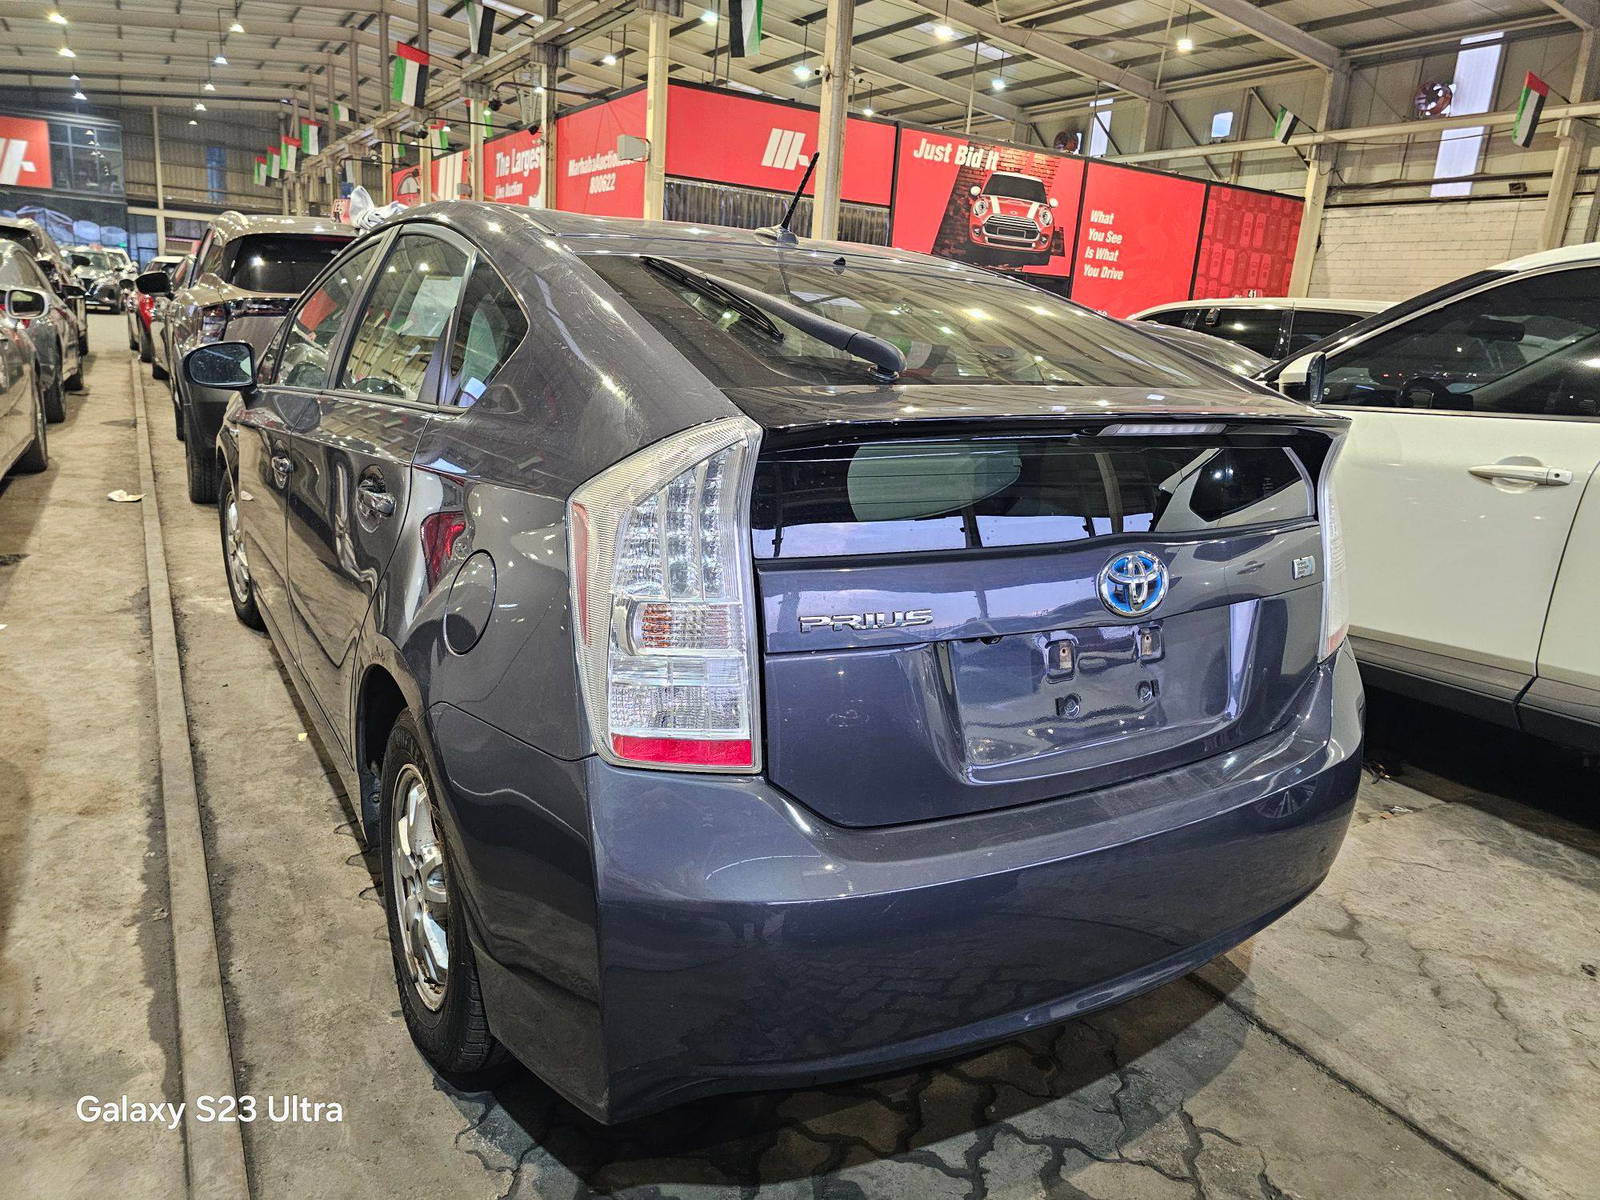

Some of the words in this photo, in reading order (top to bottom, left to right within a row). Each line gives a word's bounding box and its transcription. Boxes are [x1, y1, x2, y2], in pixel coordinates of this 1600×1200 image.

[913, 137, 952, 163] Just
[954, 144, 984, 169] Bid
[985, 149, 1000, 172] It
[495, 151, 511, 178] The
[1090, 209, 1115, 225] What
[1088, 227, 1105, 242] You
[1105, 230, 1123, 245] See
[1084, 246, 1095, 259] Is
[1095, 247, 1119, 262] What
[1083, 263, 1100, 277] You
[1100, 266, 1125, 281] Drive
[799, 607, 934, 633] PRIUS
